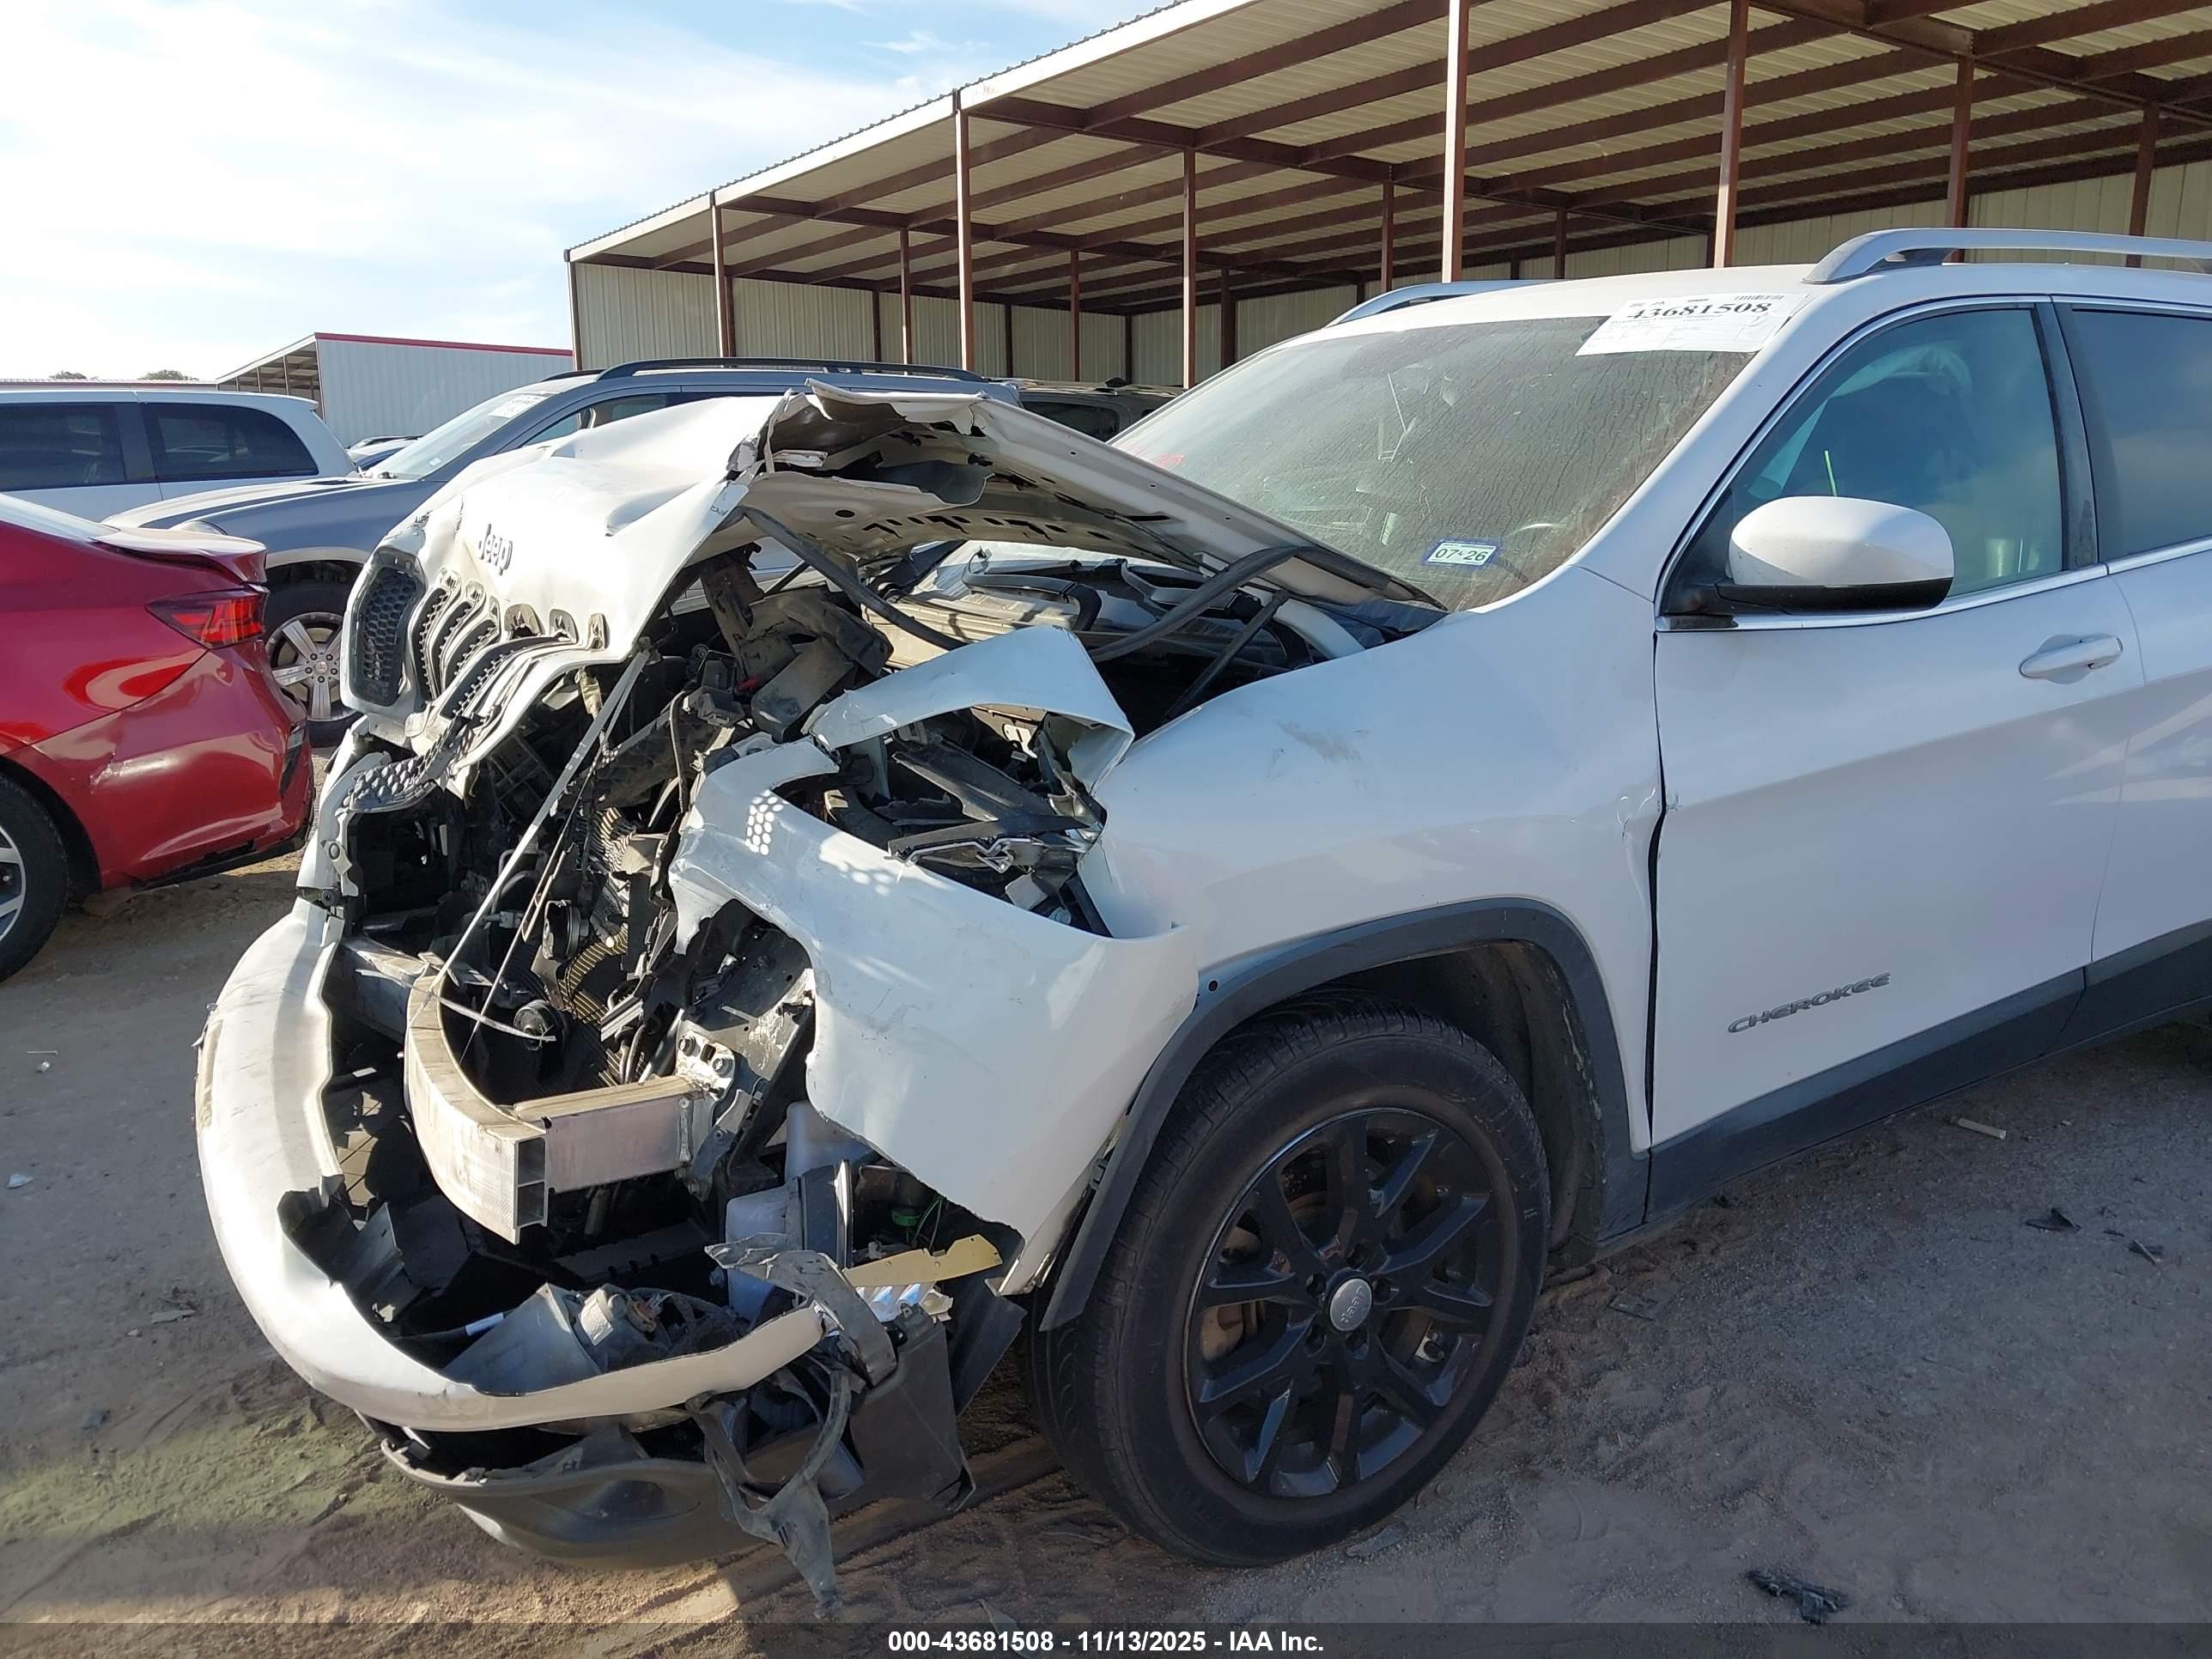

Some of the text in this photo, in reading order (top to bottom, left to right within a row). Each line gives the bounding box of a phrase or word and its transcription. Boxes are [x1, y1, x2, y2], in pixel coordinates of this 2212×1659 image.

[1627, 302, 1771, 319] 43681508
[477, 523, 514, 576] Jeep
[1462, 550, 1488, 562] 26
[1728, 971, 1892, 1033] CHEROKEE
